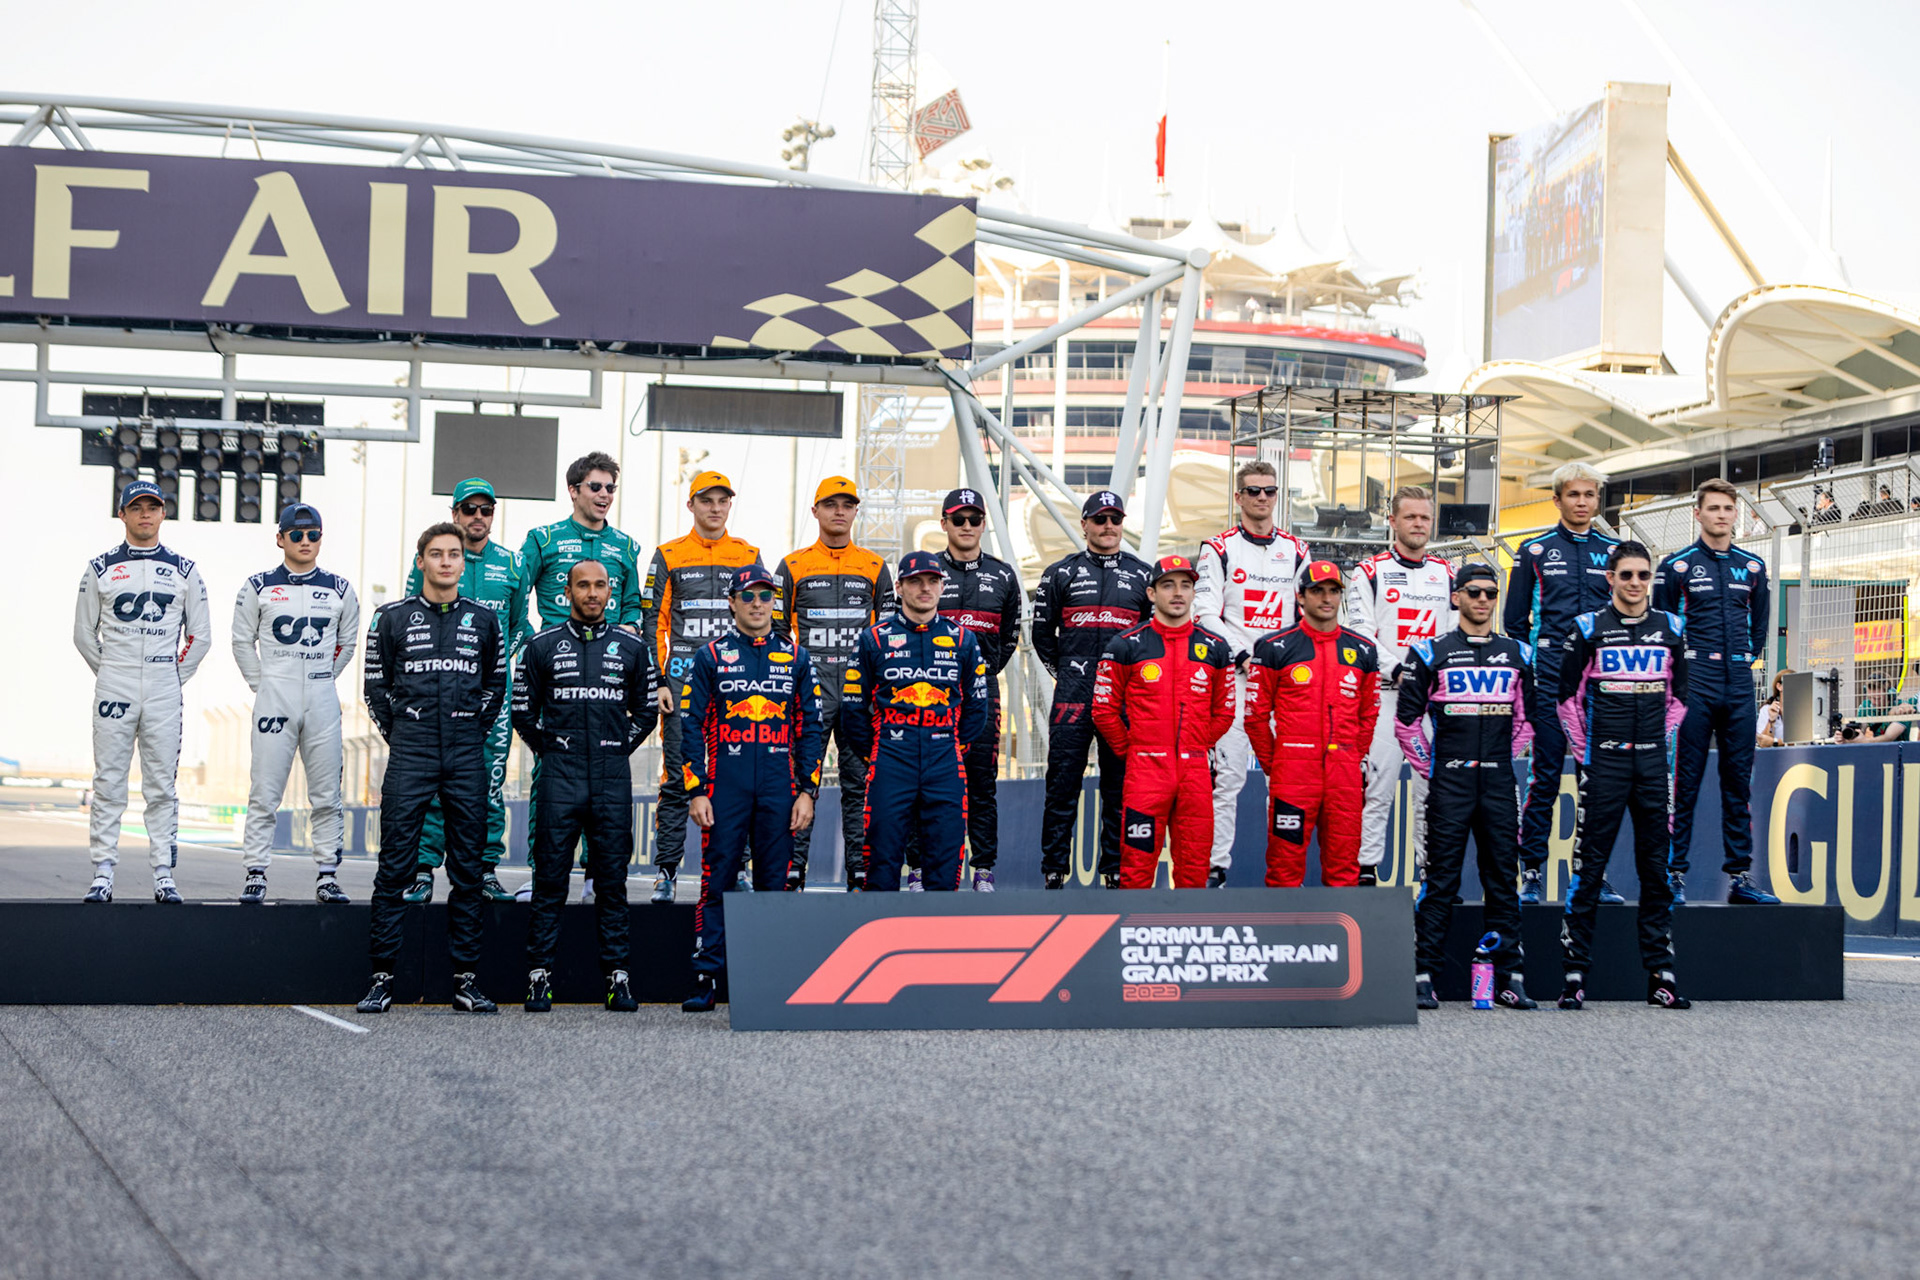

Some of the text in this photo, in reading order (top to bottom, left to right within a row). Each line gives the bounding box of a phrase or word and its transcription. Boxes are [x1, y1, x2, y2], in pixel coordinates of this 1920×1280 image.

[0, 164, 560, 326] F AIR
[1248, 573, 1293, 584] MoneyGram
[1402, 592, 1446, 602] MoneyGram
[959, 614, 994, 629] Romeo
[1071, 611, 1132, 626] Alfa Romeo
[114, 626, 167, 636] ALPHATAURI
[415, 632, 431, 641] UBS
[456, 633, 479, 643] INEOS
[272, 649, 325, 661] ALPHATAURI
[934, 650, 957, 659] BYBIT
[1601, 649, 1666, 673] BWT
[404, 659, 478, 674] PETRONAS
[561, 660, 578, 668] UBS
[769, 665, 793, 674] BYBIT
[884, 667, 959, 681] ORACLE
[719, 680, 793, 694] ORACLE
[1447, 670, 1513, 693] BWT
[1635, 681, 1666, 692] EDGE
[553, 687, 624, 701] PETRONAS
[883, 707, 920, 725] Red
[1054, 703, 1085, 724] 77
[1481, 704, 1513, 715] EDGE
[719, 723, 789, 744] Red Bull
[1276, 814, 1301, 829] 55
[1127, 823, 1152, 838] 16
[1120, 926, 1257, 945] FORMULA 1
[785, 914, 1119, 1004] F1
[1121, 944, 1339, 964] GULF AIR BAHRAIN
[1122, 964, 1269, 982] GRAND PRIX
[1124, 986, 1178, 999] 2023
